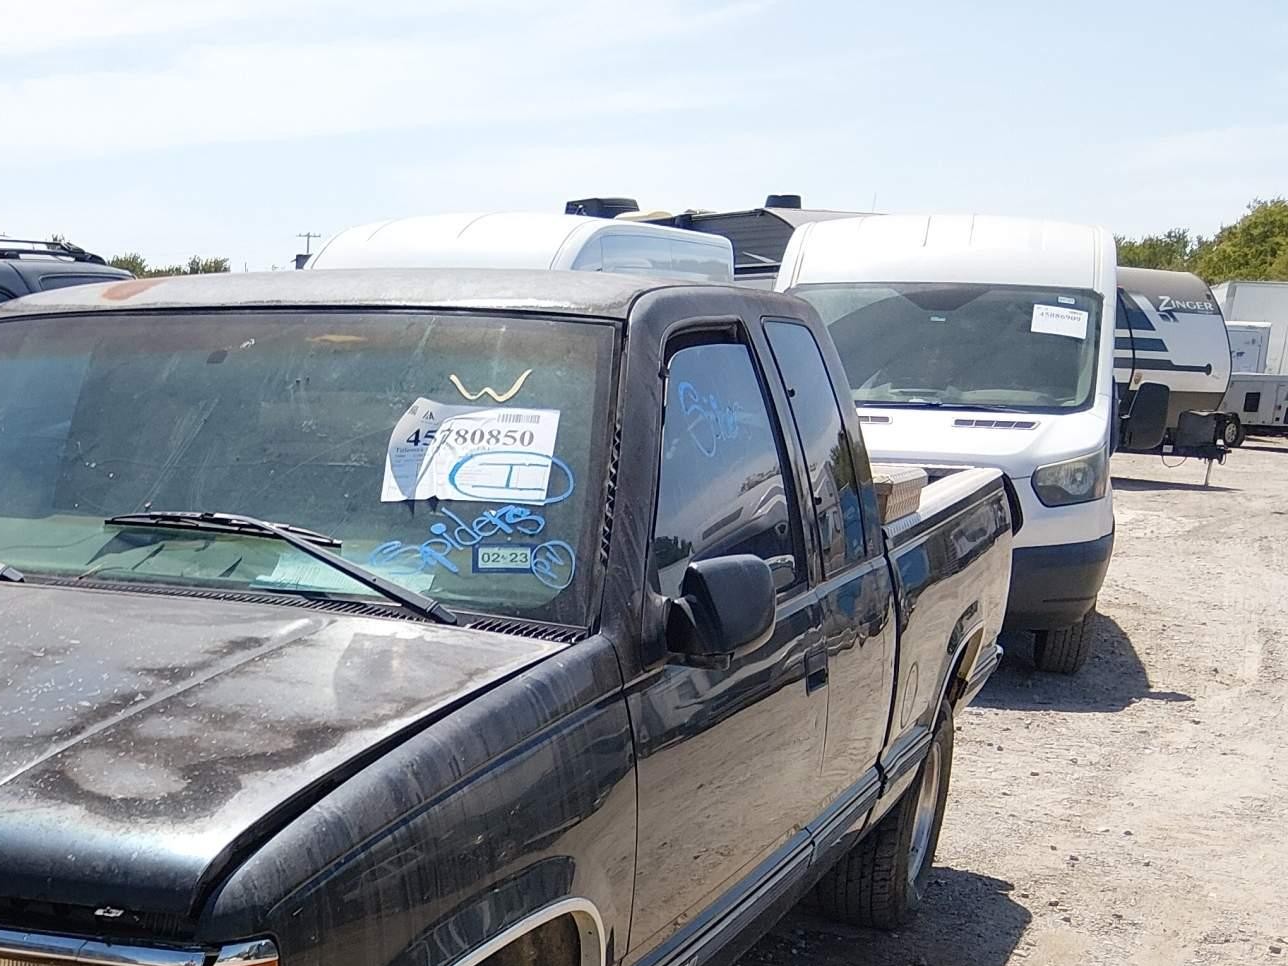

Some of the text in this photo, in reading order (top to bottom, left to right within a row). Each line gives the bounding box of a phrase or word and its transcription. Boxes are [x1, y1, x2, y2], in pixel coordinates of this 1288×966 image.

[1158, 295, 1214, 312] ZINGER
[406, 427, 535, 448] 45780850
[481, 551, 529, 564] 02 23
